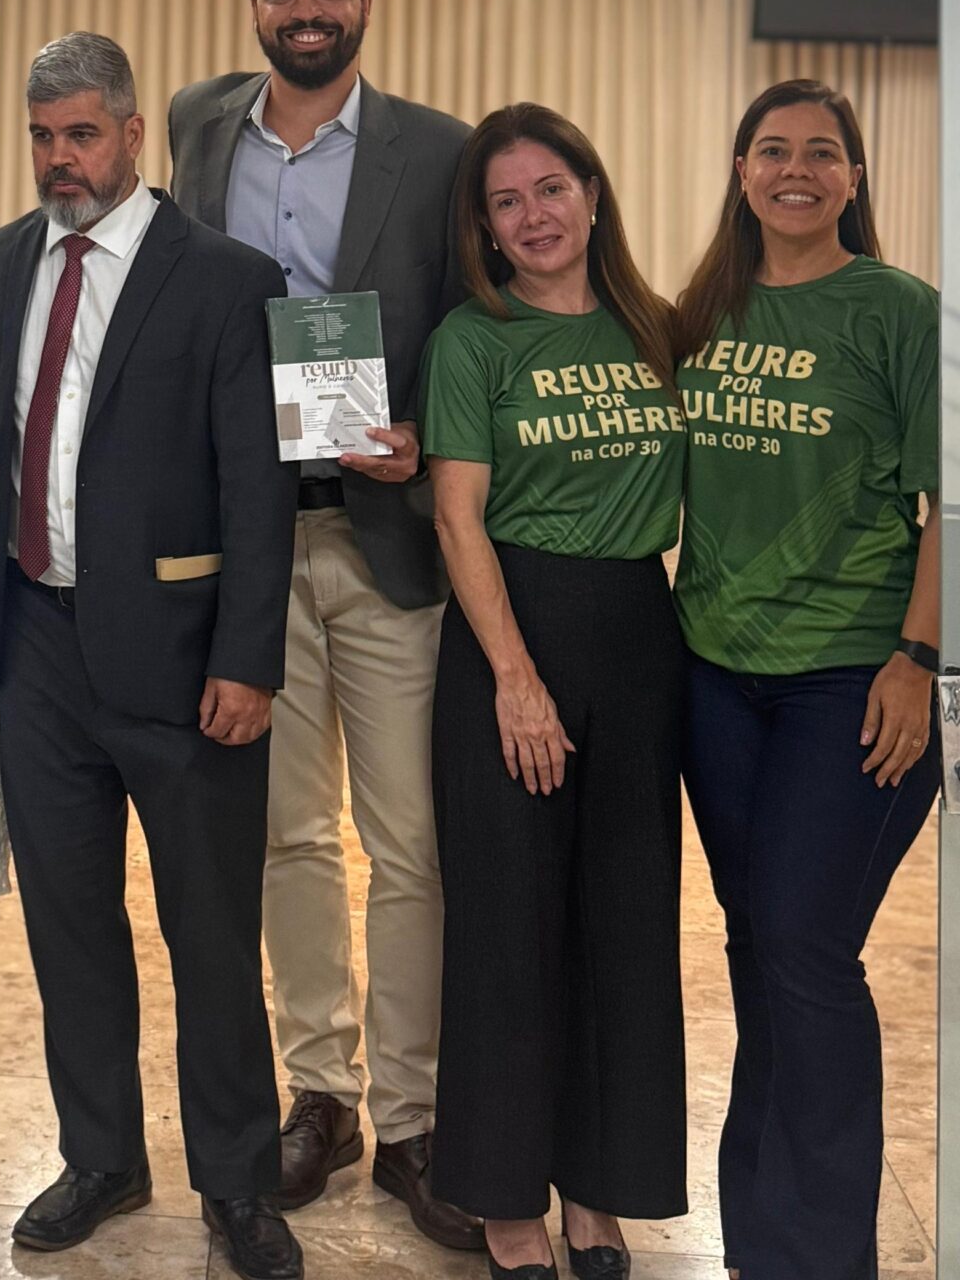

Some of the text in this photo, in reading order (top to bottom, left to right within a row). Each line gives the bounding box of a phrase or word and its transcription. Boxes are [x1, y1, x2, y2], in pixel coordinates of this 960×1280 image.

[300, 356, 357, 377] reurb
[532, 362, 663, 398] REURB
[718, 374, 763, 395] POR
[582, 392, 630, 411] POR
[682, 389, 834, 437] ULHERES
[517, 405, 688, 447] MULHERE
[571, 440, 661, 462] na COP 30
[694, 430, 781, 456] na COP 30
